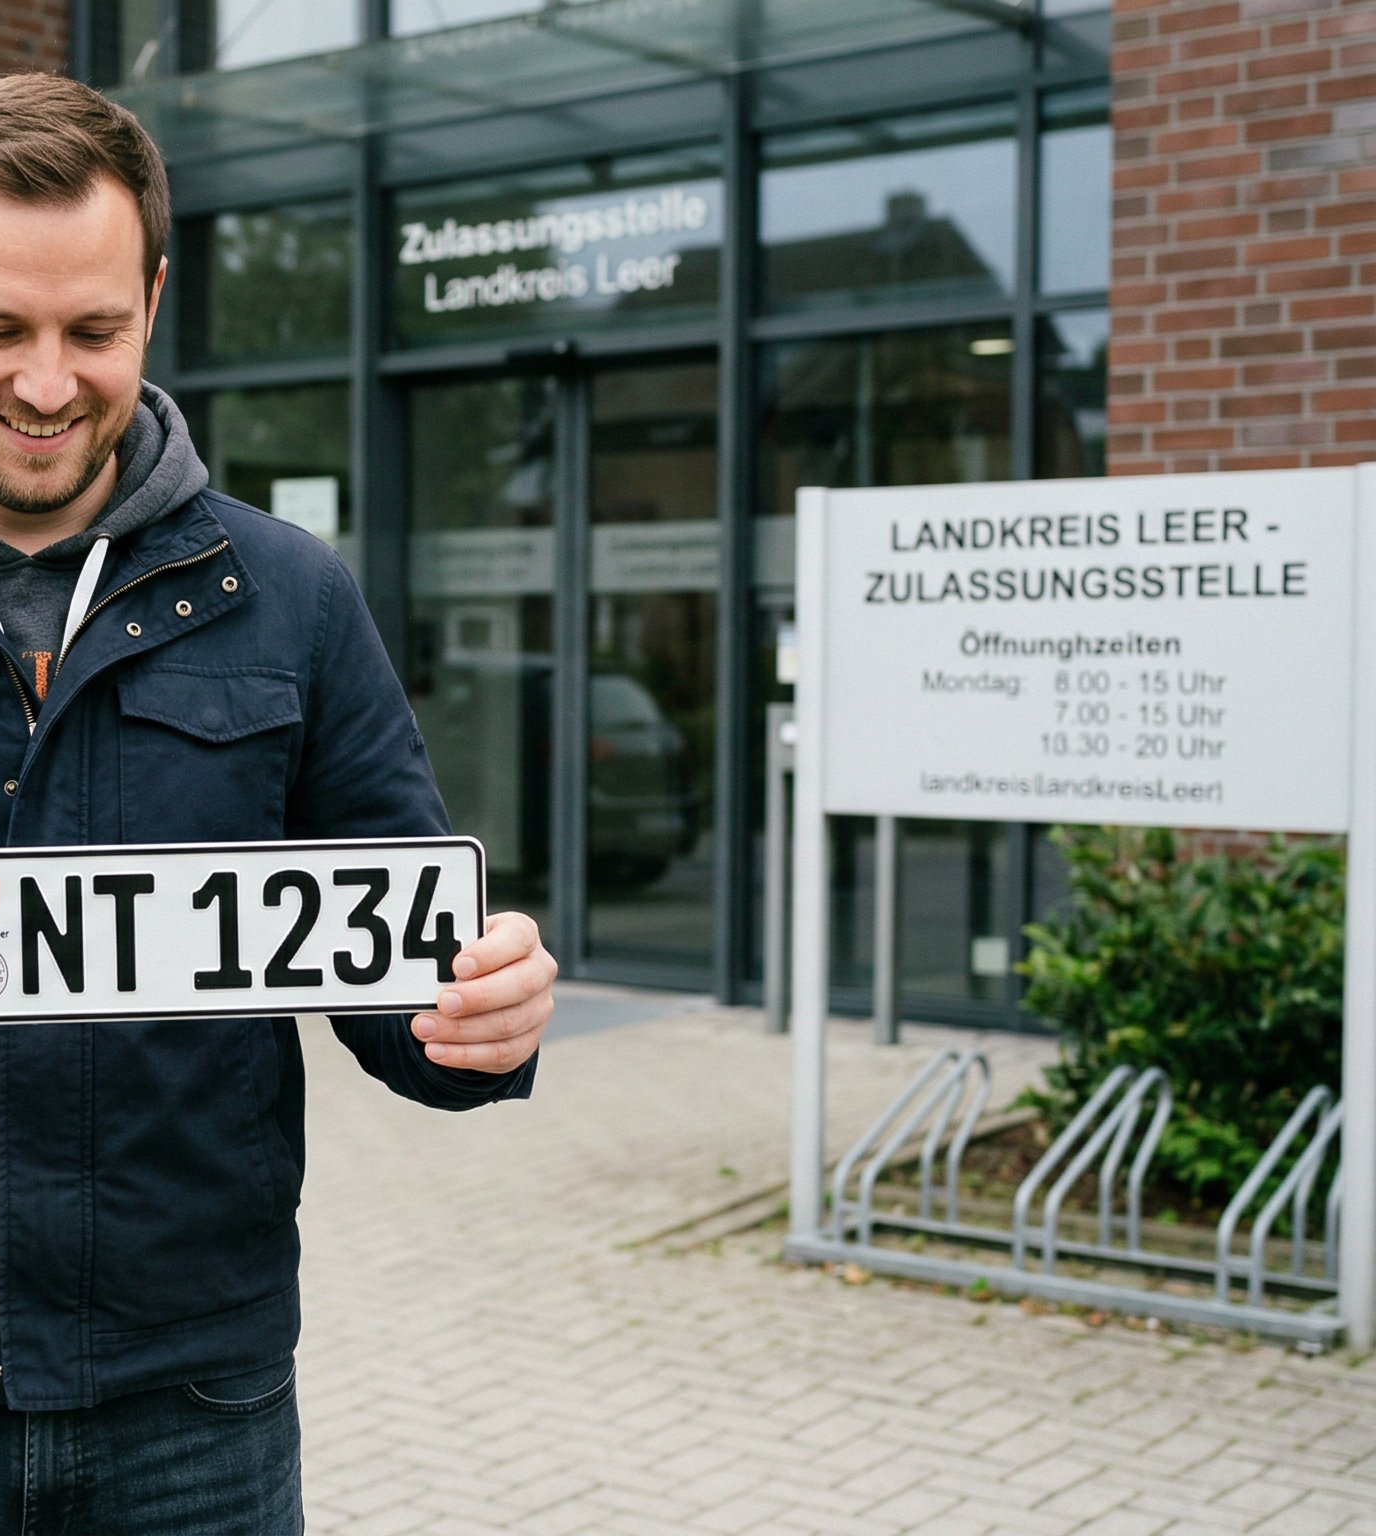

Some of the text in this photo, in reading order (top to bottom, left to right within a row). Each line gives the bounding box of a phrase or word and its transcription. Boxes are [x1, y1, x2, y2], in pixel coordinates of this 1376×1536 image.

[399, 190, 708, 266] Zulassungsstelle
[424, 252, 683, 313] Landkreis Leer
[890, 511, 1122, 553] LANDKREIS
[1136, 507, 1250, 546] LEER
[862, 561, 1309, 605] ZULASSUNGSSTELLE
[958, 628, 1183, 662] Öffnunghzeiten
[1053, 670, 1111, 695] 8.00
[1138, 670, 1170, 696] 15
[1176, 671, 1227, 696] Uhr
[1055, 701, 1111, 726] 7.00
[1138, 702, 1170, 727] 15
[1176, 703, 1227, 728] Uhr
[1134, 733, 1170, 760] 20
[1176, 735, 1226, 761] Uhr
[20, 873, 156, 995] NT
[192, 865, 462, 990] 1234
